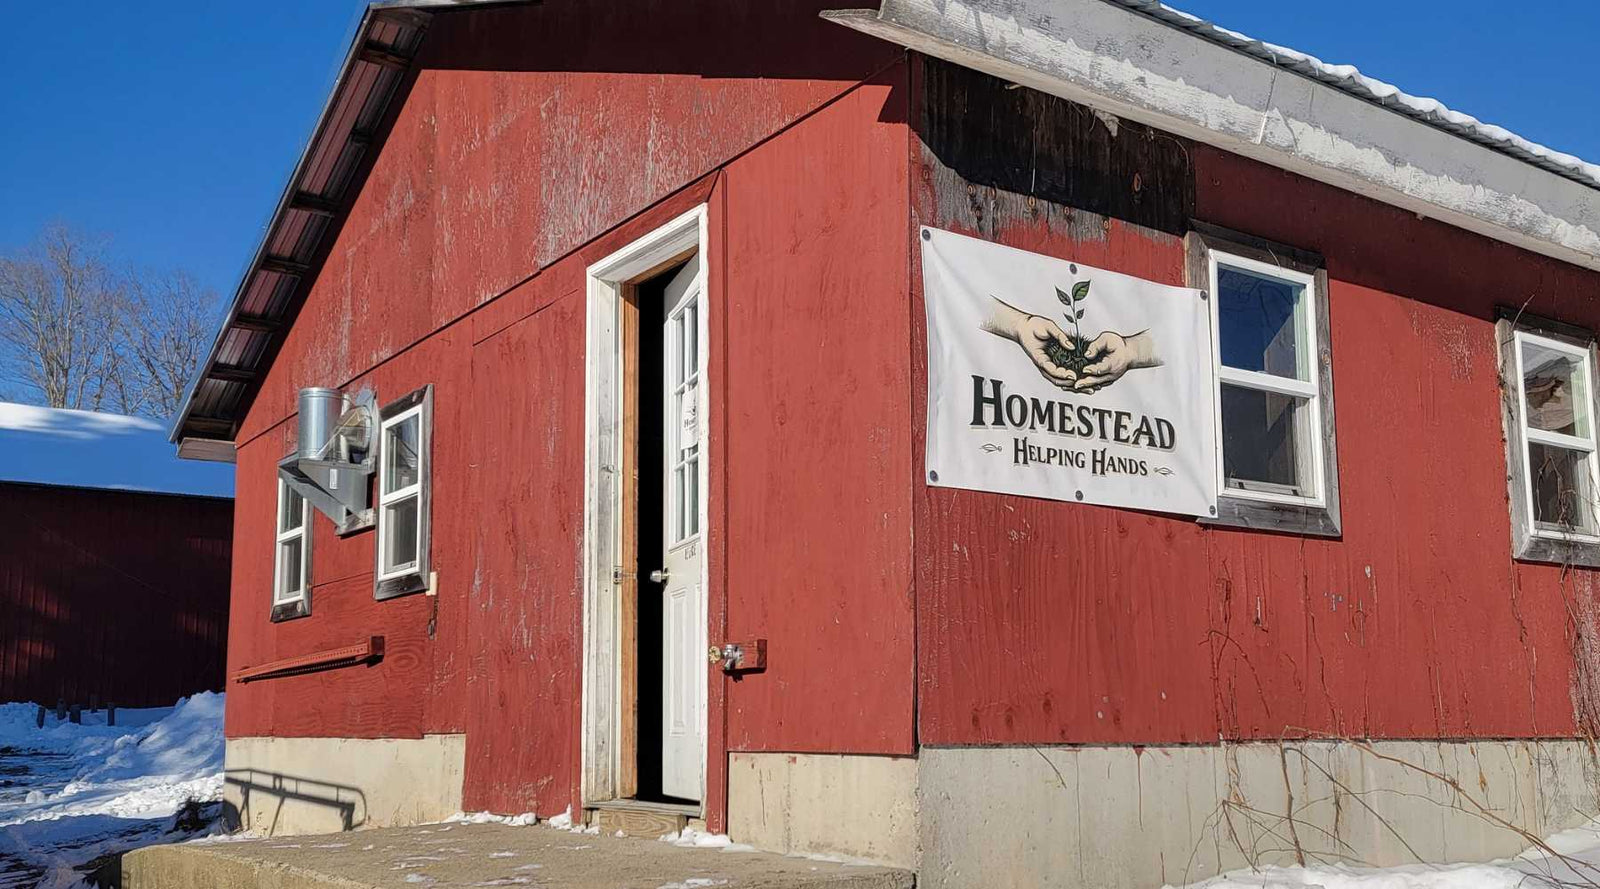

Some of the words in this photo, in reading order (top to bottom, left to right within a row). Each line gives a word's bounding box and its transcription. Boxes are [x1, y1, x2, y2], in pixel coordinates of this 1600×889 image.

[970, 375, 1176, 451] HOMESTEAD
[1014, 437, 1085, 467] HELPING
[1092, 448, 1148, 476] HANDS
